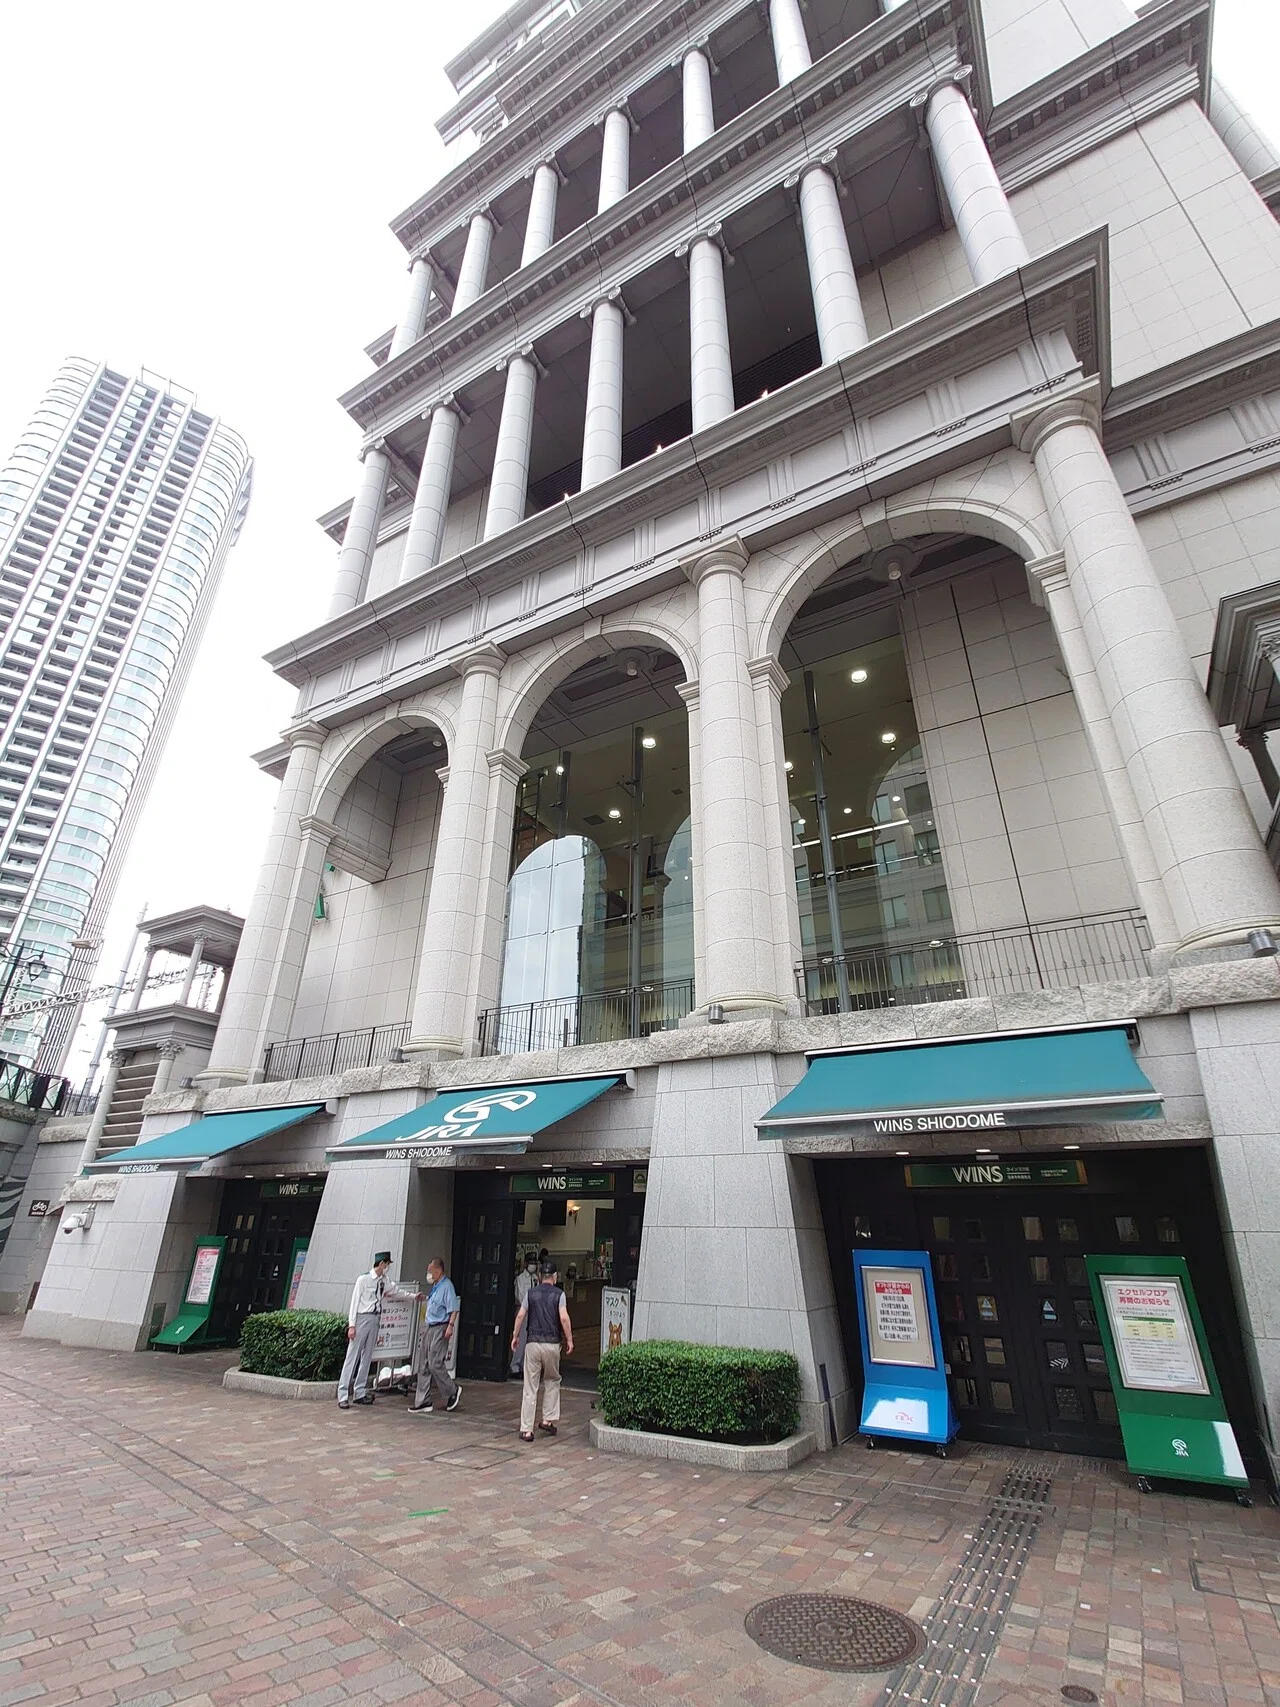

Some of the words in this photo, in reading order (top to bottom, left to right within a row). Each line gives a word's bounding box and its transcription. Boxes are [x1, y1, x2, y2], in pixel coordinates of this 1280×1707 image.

[874, 1118, 913, 1132] WINS
[917, 1112, 1006, 1131] SHIODOME
[395, 1122, 483, 1141] JRA
[385, 1149, 406, 1159] WINS
[407, 1146, 453, 1158] SHIODOME
[952, 1165, 1004, 1183] WINS
[279, 1183, 299, 1195] WINS
[537, 1176, 567, 1190] WINS
[1117, 1288, 1168, 1297] エクセルフロア
